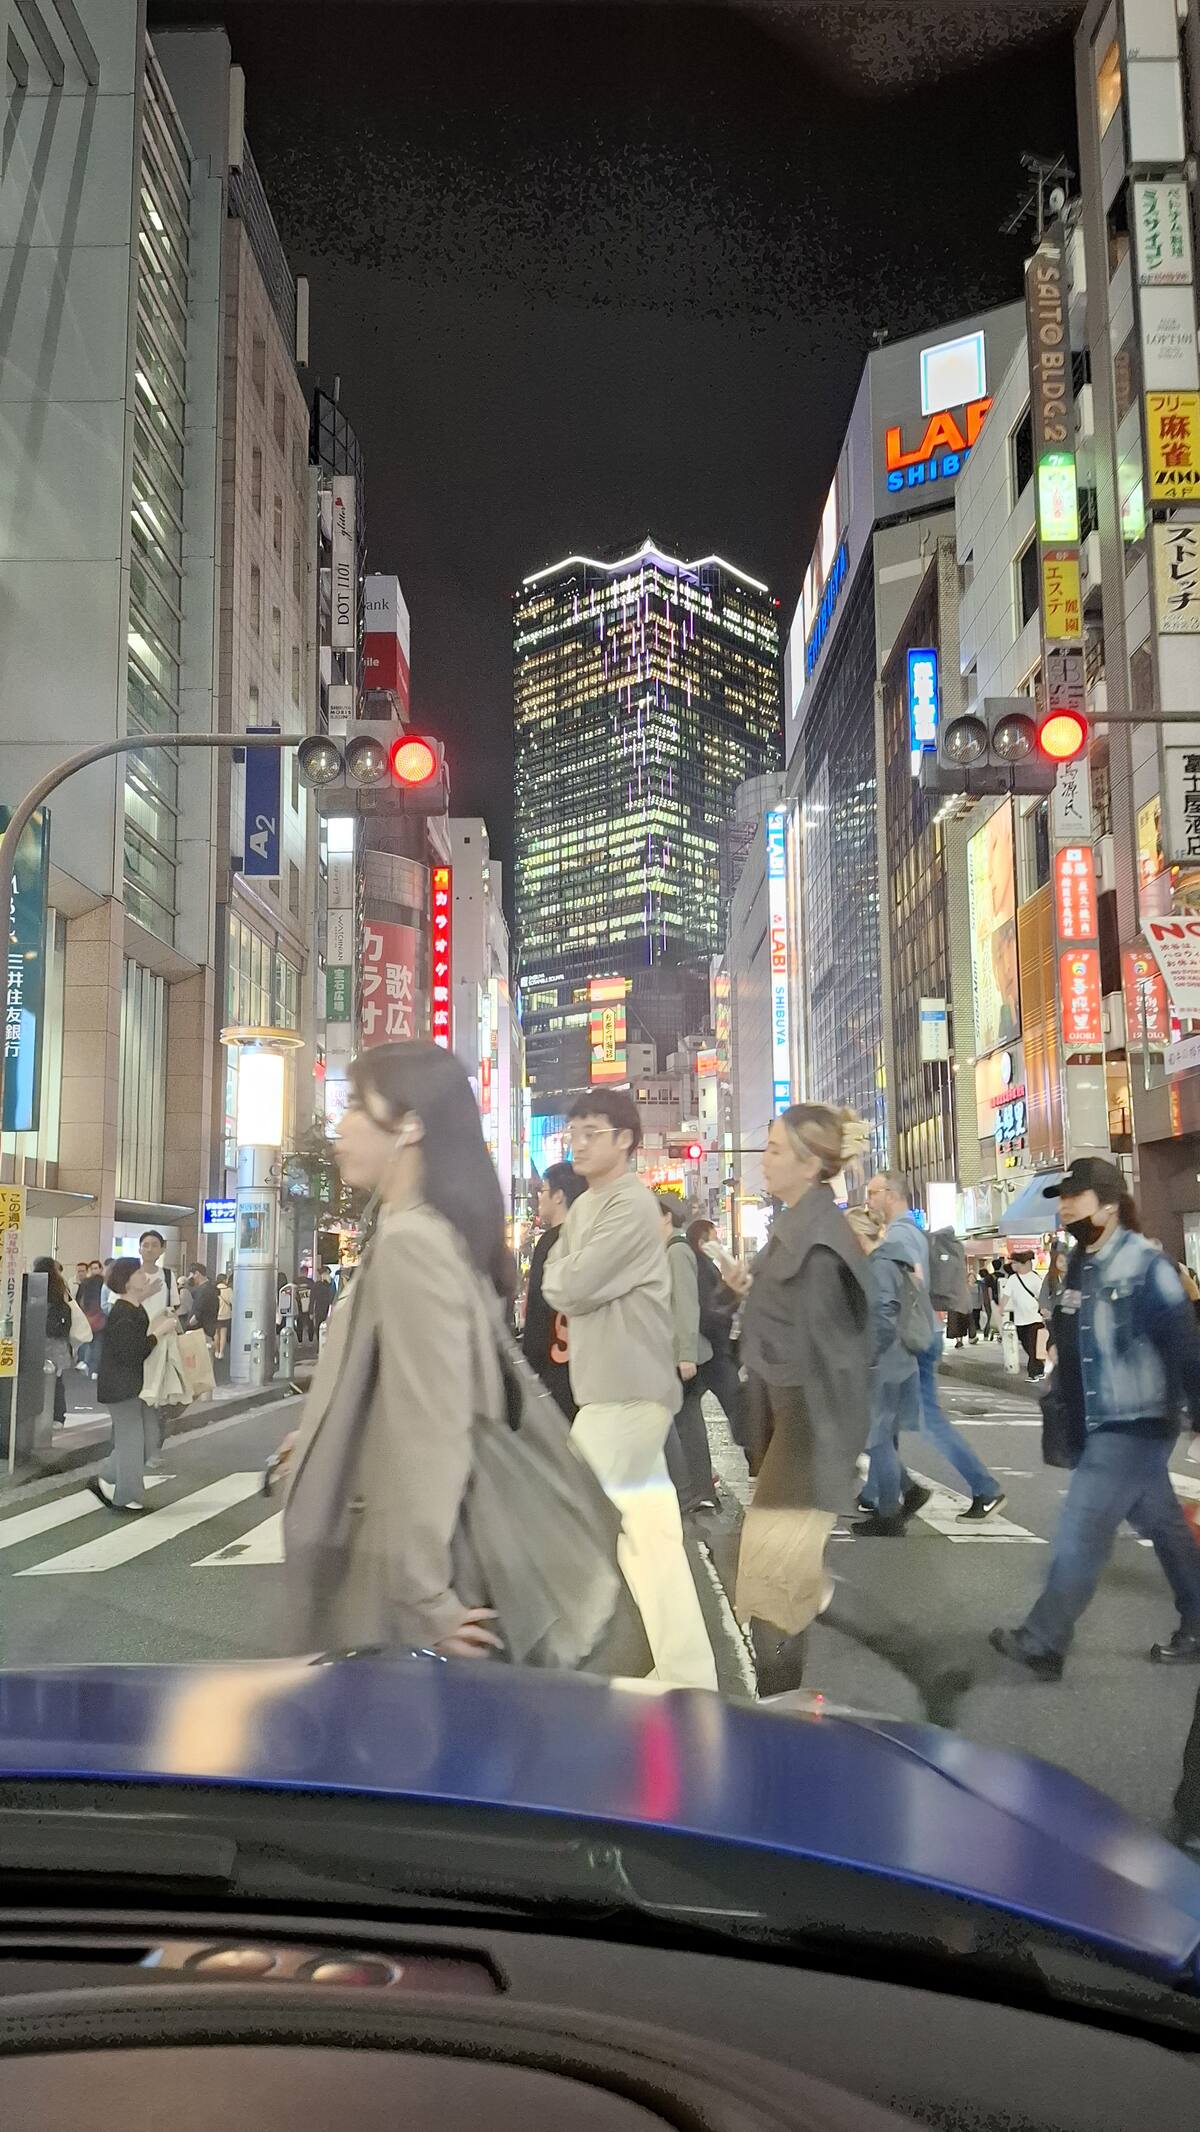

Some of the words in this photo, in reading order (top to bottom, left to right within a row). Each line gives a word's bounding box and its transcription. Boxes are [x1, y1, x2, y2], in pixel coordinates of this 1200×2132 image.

[1037, 266, 1064, 346] SAITO
[1150, 395, 1196, 411] フリー
[1159, 414, 1193, 468] 麻雀
[887, 448, 972, 493] SHIB
[336, 506, 353, 542] glitter
[1045, 567, 1063, 616] エステ
[1163, 527, 1200, 613] ストレッチ
[337, 593, 350, 626] DOT
[365, 598, 390, 611] ank
[249, 814, 276, 860] A2
[771, 928, 787, 974] LABI
[4, 953, 24, 1059] 三井住友銀行
[775, 986, 785, 1046] SHIBUYA
[1078, 1054, 1092, 1064] 1F
